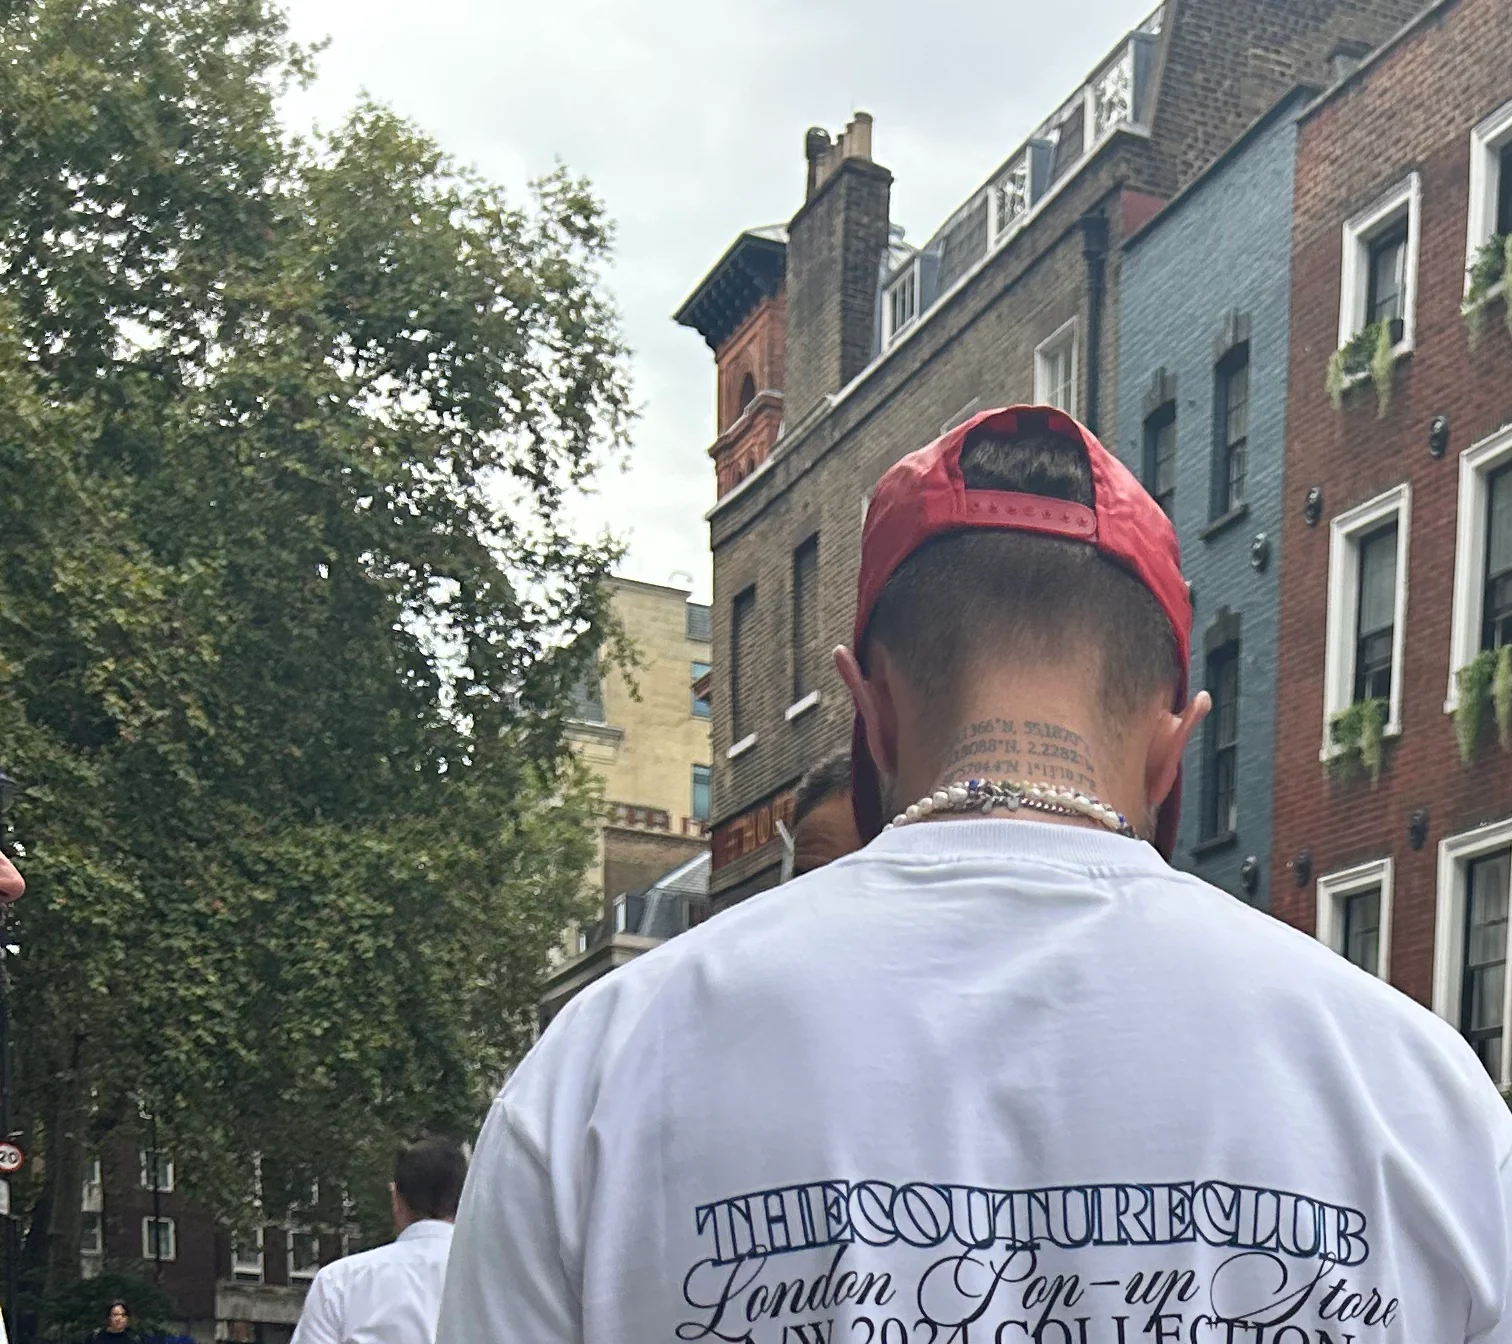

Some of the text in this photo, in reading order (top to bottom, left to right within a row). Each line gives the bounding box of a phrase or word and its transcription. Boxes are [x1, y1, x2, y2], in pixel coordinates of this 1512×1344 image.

[675, 1237, 1400, 1342] London Pop-up Store
